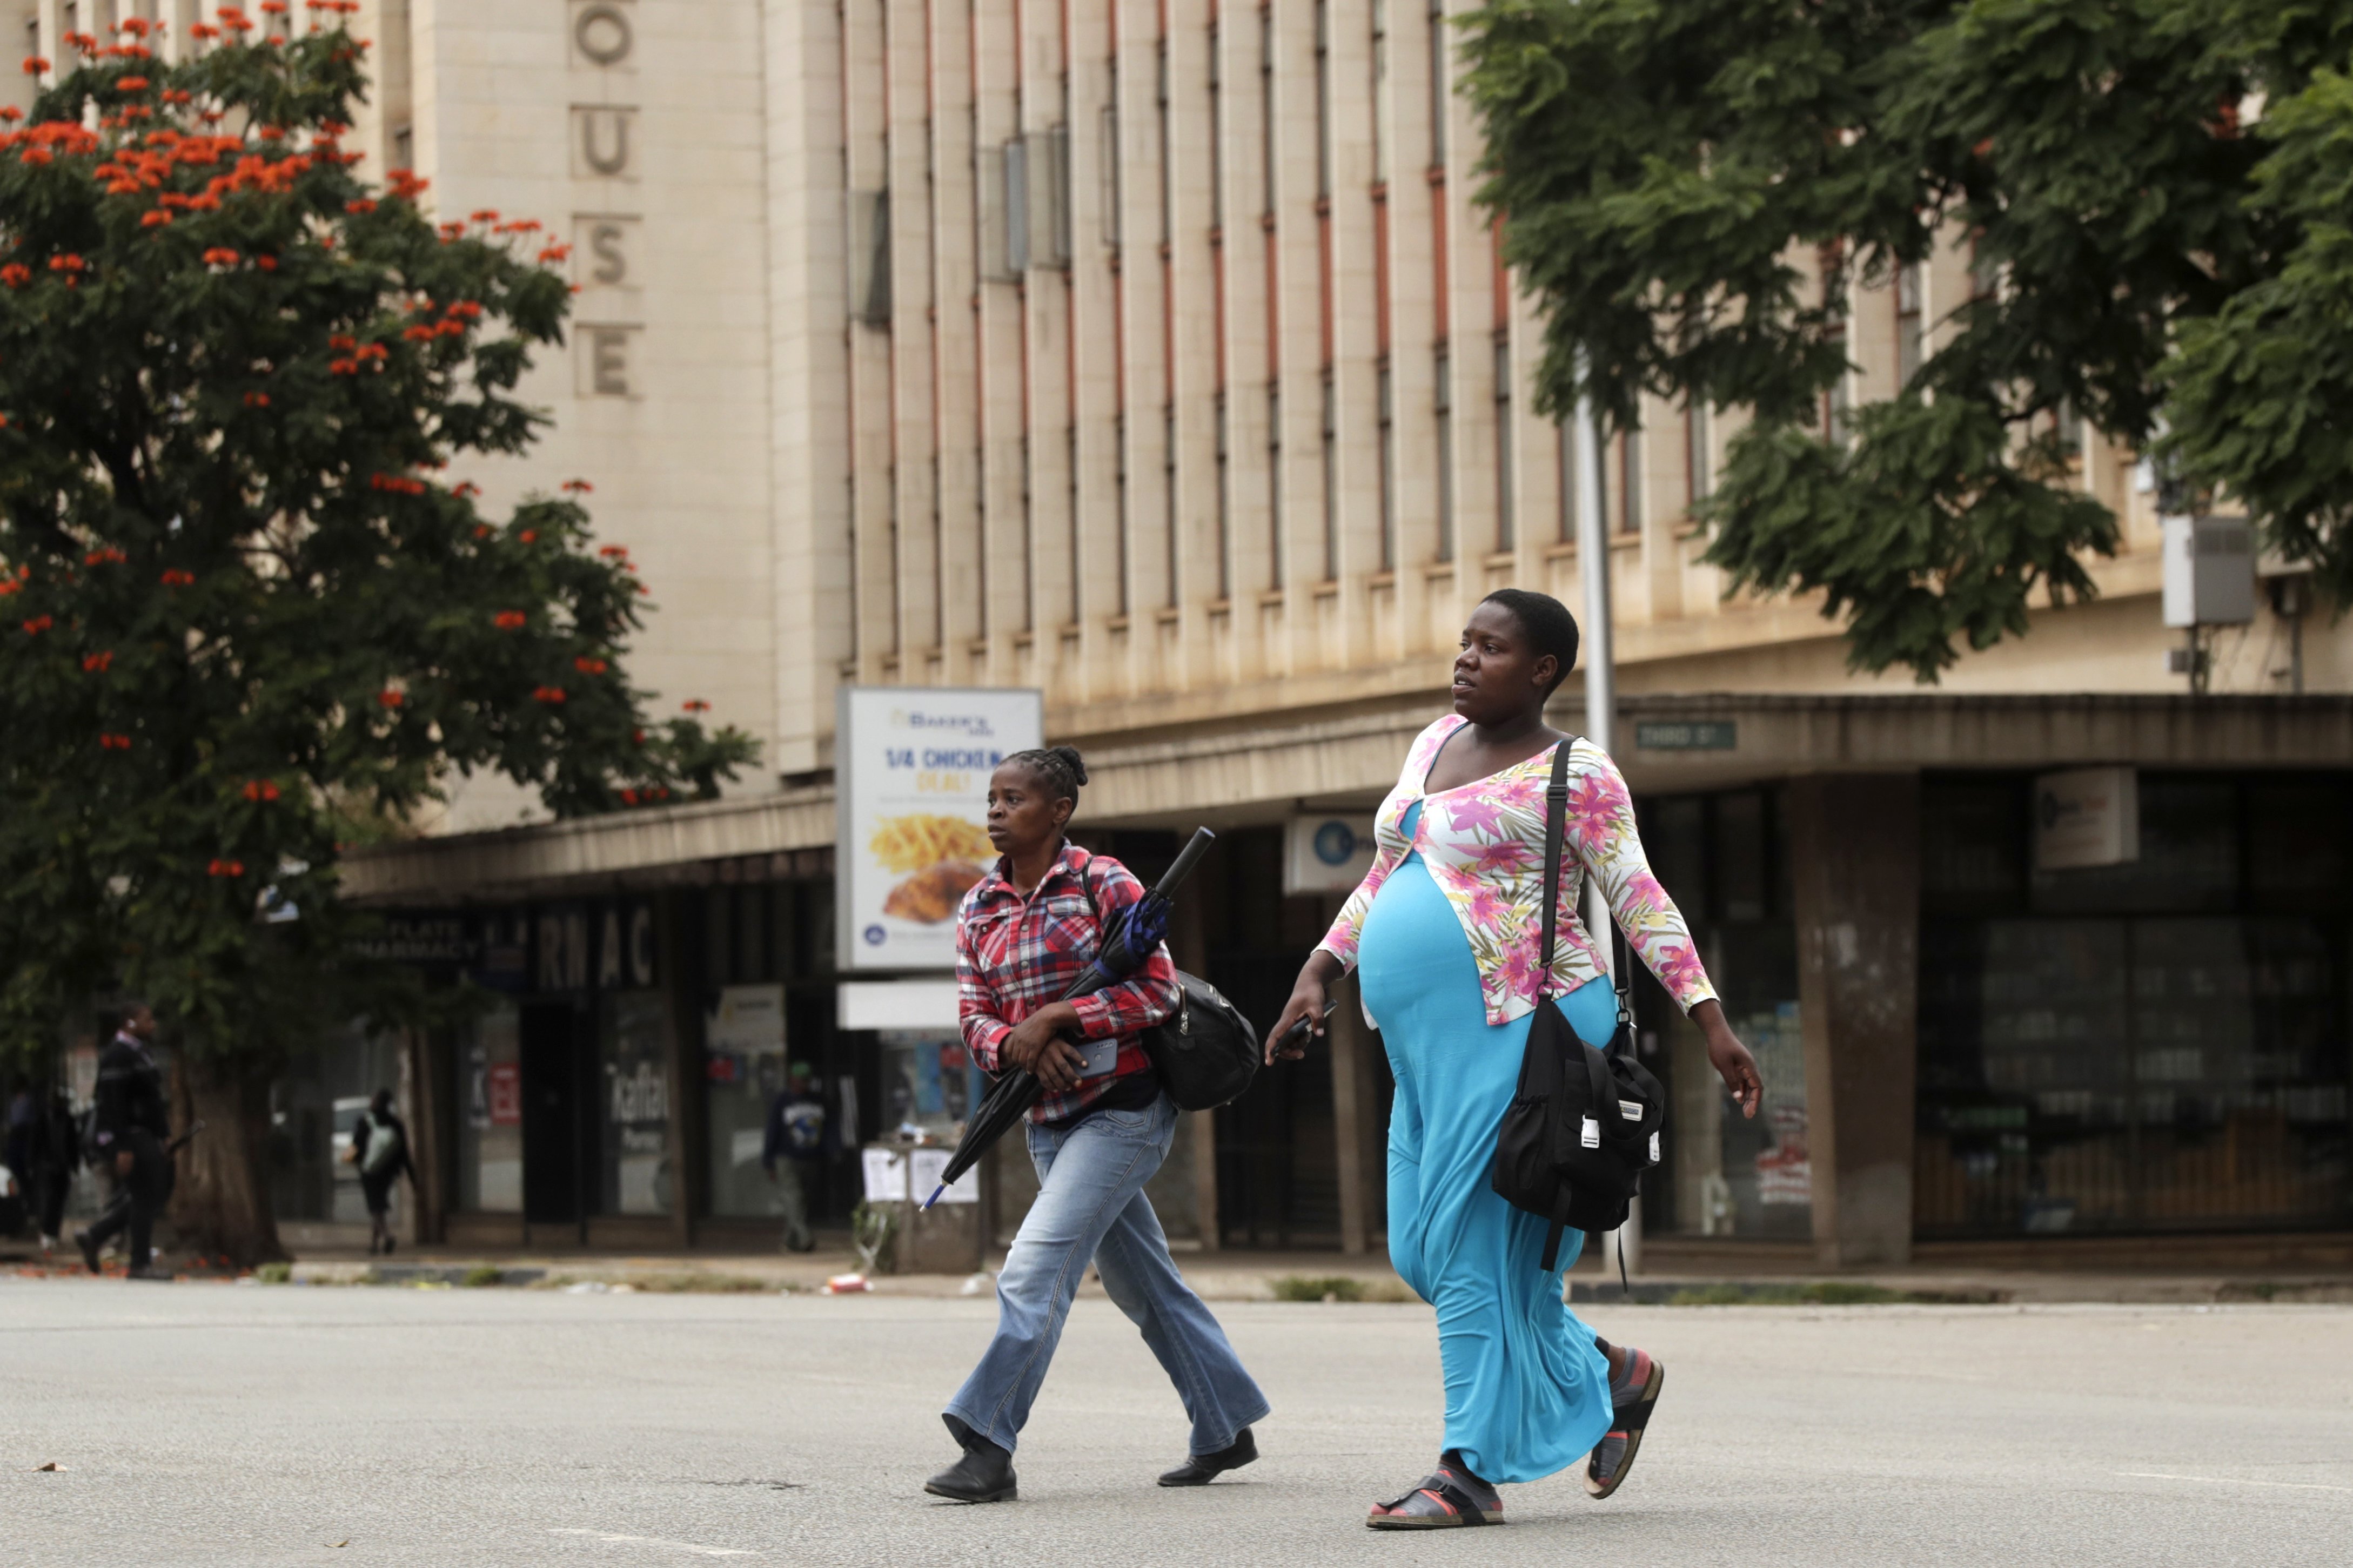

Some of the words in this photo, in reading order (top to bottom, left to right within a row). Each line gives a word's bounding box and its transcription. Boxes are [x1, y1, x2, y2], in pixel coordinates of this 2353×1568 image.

[574, 5, 632, 395] OUSE
[885, 748, 915, 769] 1/4
[923, 748, 1003, 770] CHICKEN
